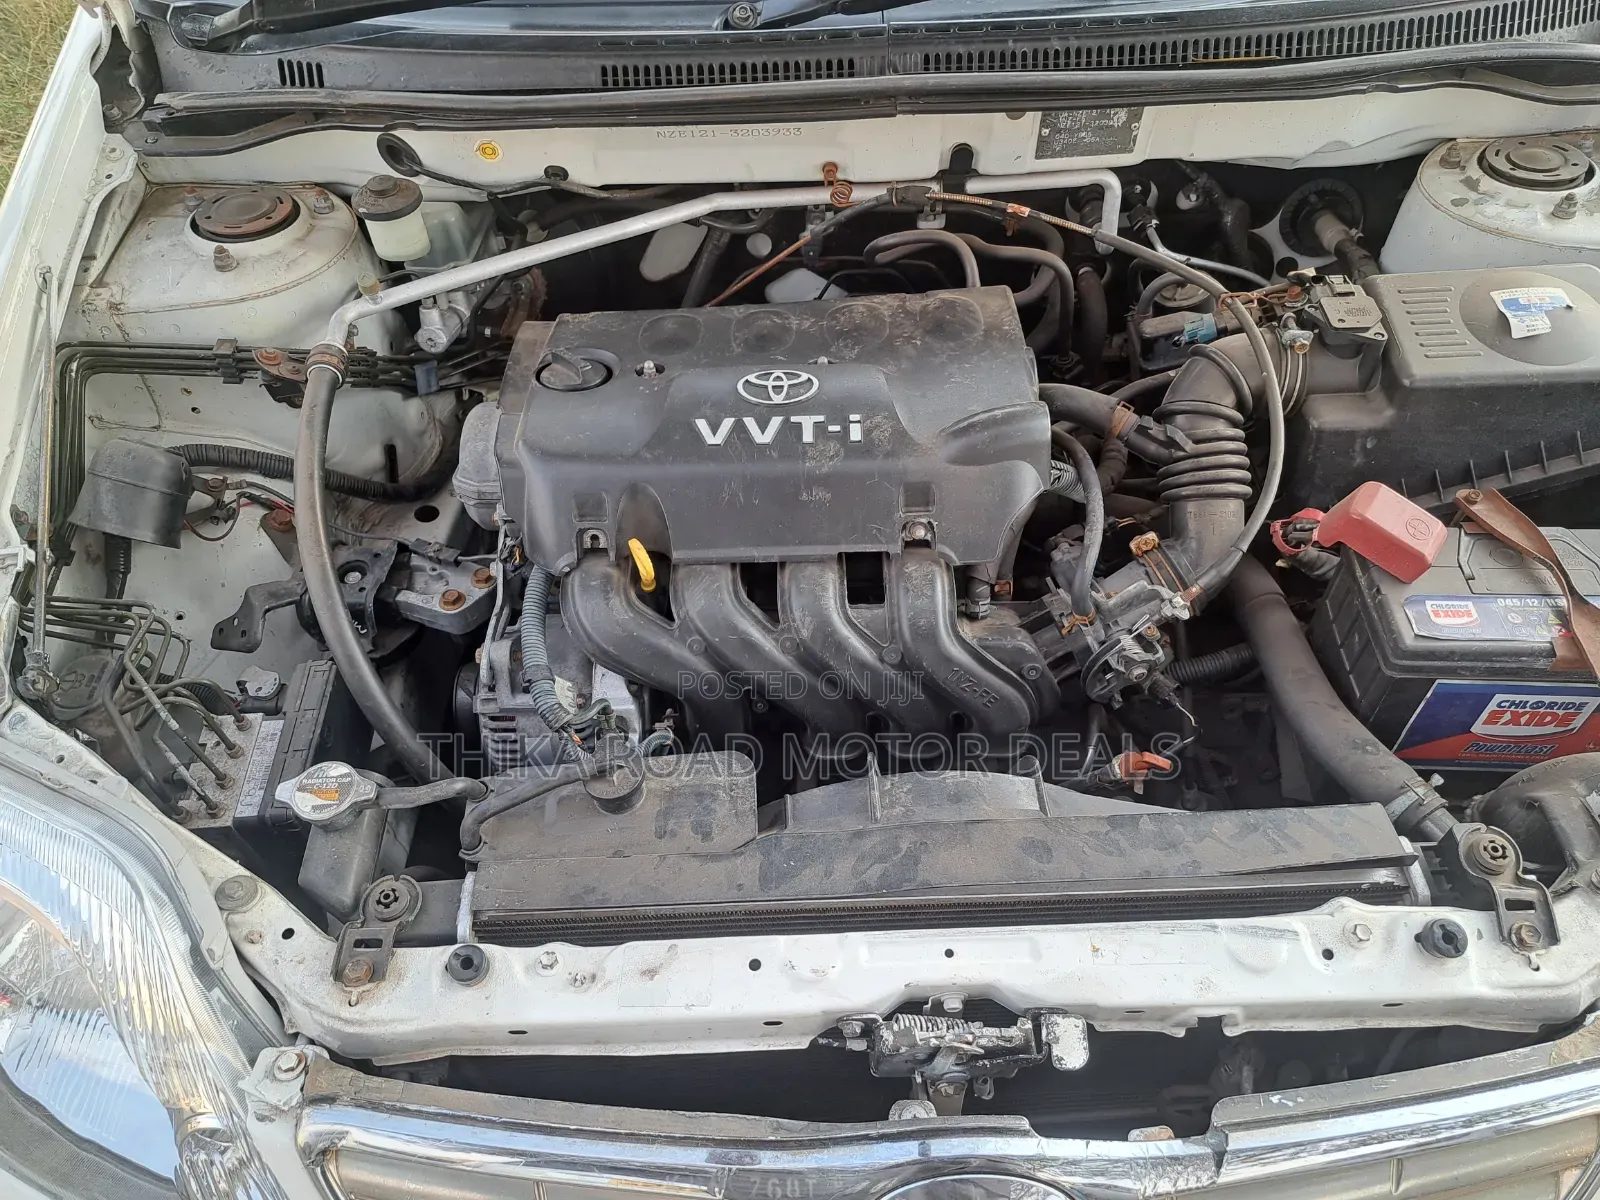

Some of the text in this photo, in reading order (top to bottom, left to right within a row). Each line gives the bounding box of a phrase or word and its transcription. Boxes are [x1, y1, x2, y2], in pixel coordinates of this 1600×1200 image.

[656, 126, 803, 139] NZE121-3203933
[693, 413, 864, 447] VVT-i
[1431, 609, 1474, 618] EXIDE
[947, 667, 1000, 708] 1NZ-FE
[1495, 699, 1590, 711] CHLORIDE
[1481, 709, 1584, 728] EXIDE
